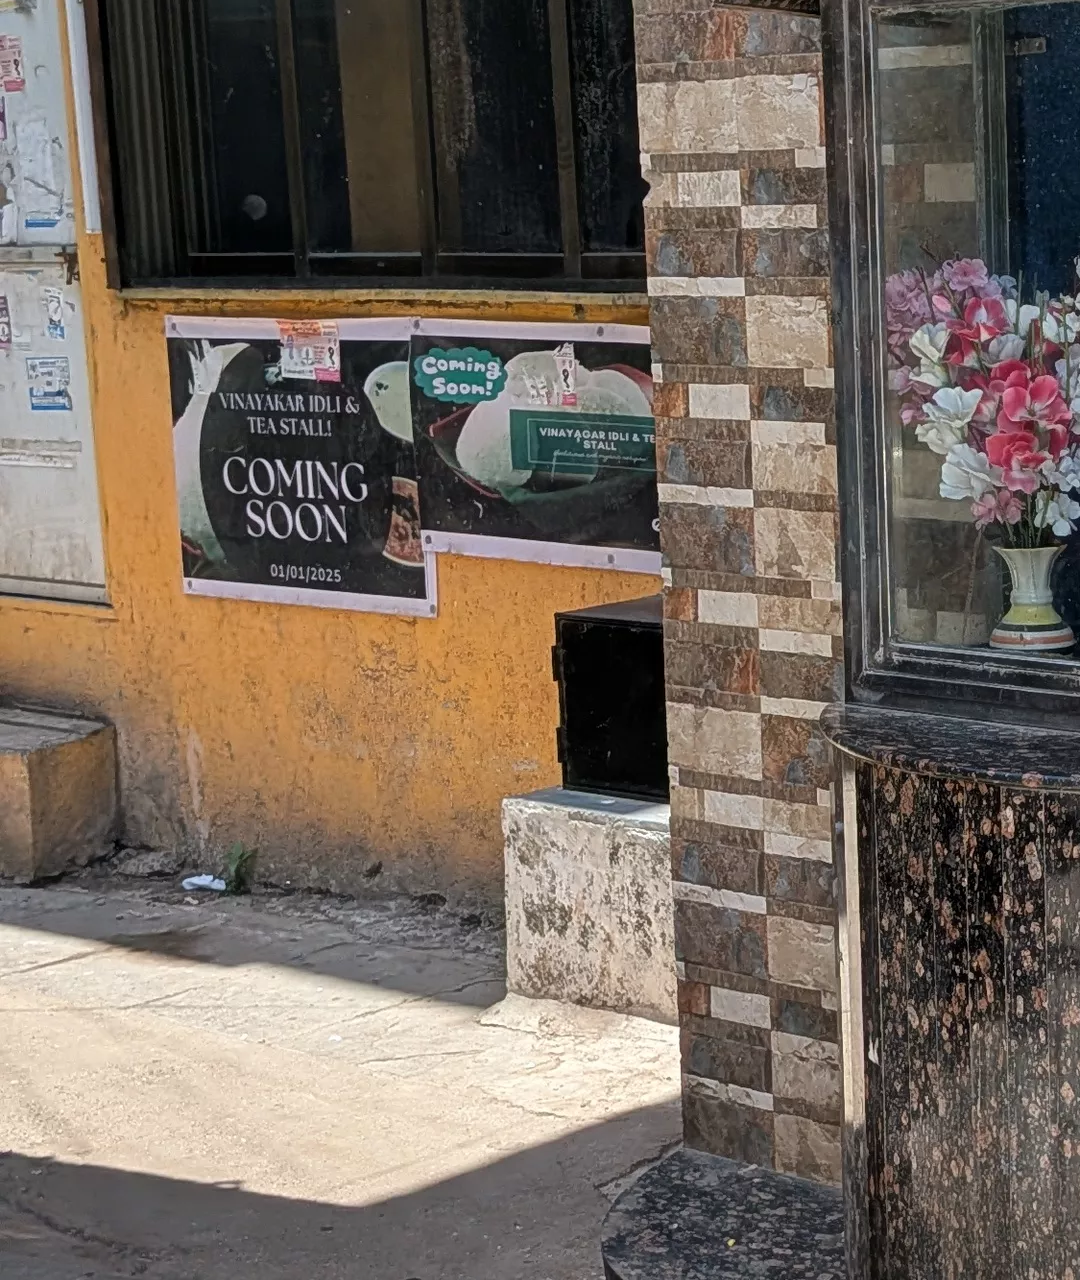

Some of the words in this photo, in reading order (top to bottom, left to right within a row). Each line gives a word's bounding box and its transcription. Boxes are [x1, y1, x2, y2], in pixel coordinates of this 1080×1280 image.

[422, 356, 502, 380] Coming
[432, 377, 493, 396] Soon!
[219, 392, 305, 413] VINAYAKAR
[309, 395, 341, 413] IDLI
[345, 396, 360, 414] &
[247, 417, 277, 435] TEA
[280, 418, 332, 437] STALL!
[539, 427, 606, 440] VINAYAGAR
[608, 431, 629, 441] IDLI
[632, 433, 640, 442] &
[642, 433, 656, 443] TE
[583, 440, 617, 451] STALL
[222, 456, 369, 503] COMING
[245, 499, 348, 544] SOON
[270, 563, 342, 583] 01/01/2025
